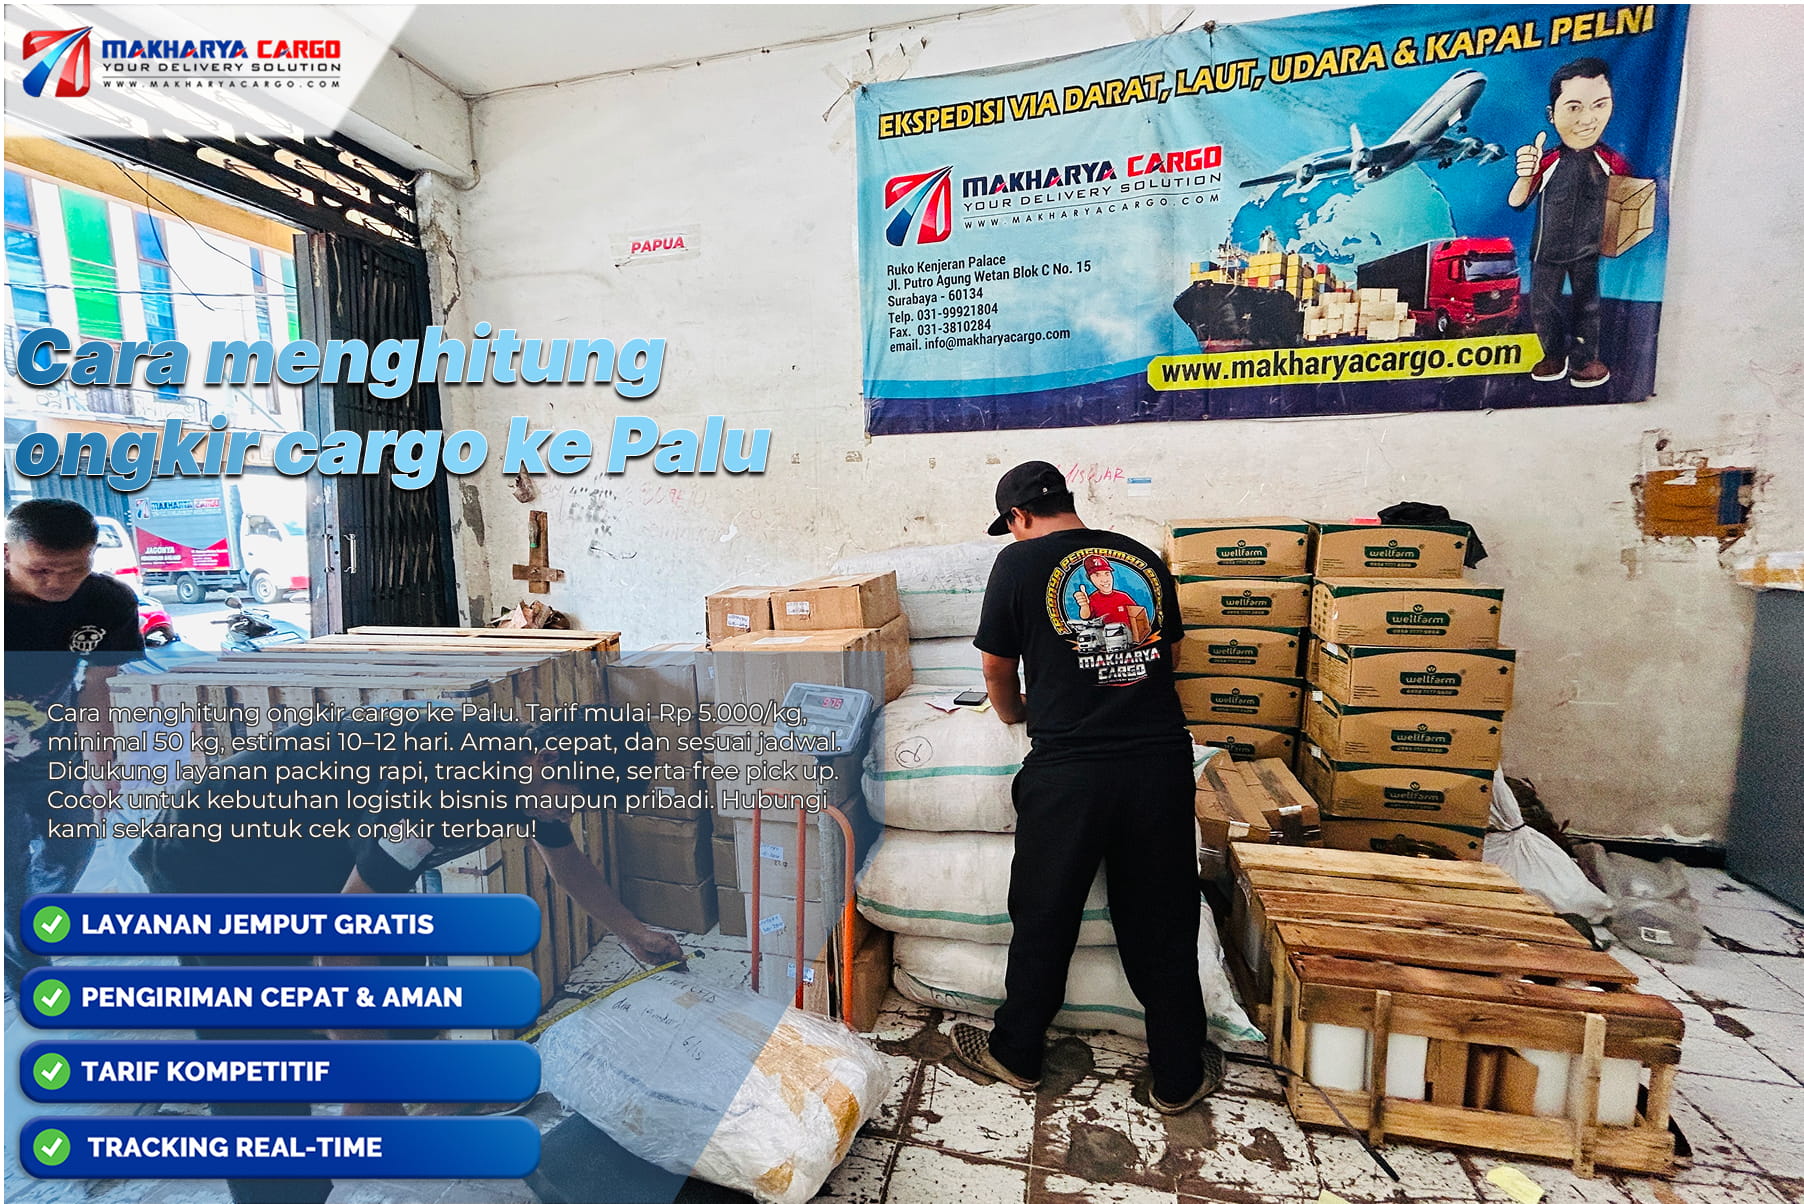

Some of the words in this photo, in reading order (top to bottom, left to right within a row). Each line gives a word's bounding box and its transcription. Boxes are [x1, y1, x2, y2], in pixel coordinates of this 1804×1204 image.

[878, 97, 1004, 139] EKSPEDISI
[1010, 89, 1061, 121] VIA
[1063, 73, 1170, 113] DARAT,
[1176, 57, 1264, 97] LAUT,
[1269, 42, 1385, 86] UDARA
[1392, 38, 1417, 66] &
[1424, 20, 1542, 64] KAPAL
[1549, 4, 1656, 46] PELNI
[963, 160, 1117, 198] MAKHARYA
[1127, 146, 1222, 177] CARGO
[964, 197, 1012, 211] YOUR
[1020, 185, 1112, 206] DELIVERY
[1120, 173, 1222, 193] SOLUTION
[631, 236, 685, 254] PAPUA
[887, 263, 914, 276] Ruko
[917, 260, 965, 274] Kenjeran
[968, 254, 1006, 269] Palace
[887, 278, 902, 292] Jl.
[904, 275, 934, 290] Putro
[936, 273, 972, 289] Agung
[974, 269, 1010, 283] Wetan
[1012, 266, 1039, 279] Blok
[1041, 264, 1050, 277] C
[1052, 263, 1073, 276] No.
[1076, 260, 1091, 273] 15
[887, 293, 938, 308] Surabaya
[948, 287, 984, 302] 60134
[888, 311, 914, 326] Telp.
[917, 303, 999, 321] 031-99921804
[889, 326, 912, 340] Fax.
[917, 318, 992, 336] 031-3810284
[889, 338, 922, 353] email.
[924, 328, 1071, 351] info@makharyacargo.com
[1161, 343, 1521, 384] www.makharyacargo.com
[1221, 548, 1263, 557] wellfarm
[1369, 549, 1415, 557] wellfarm
[1225, 598, 1267, 606] wellfarm
[1392, 614, 1444, 623] wellfarm
[1079, 647, 1161, 668] MAKHARYA
[1212, 647, 1254, 655] wellfarm
[1099, 663, 1146, 680] CARGO
[1405, 675, 1456, 684] wellfarm
[1215, 695, 1255, 704] wellfarm
[1396, 733, 1446, 742] wellfarm
[1390, 791, 1439, 800] wellfarm
